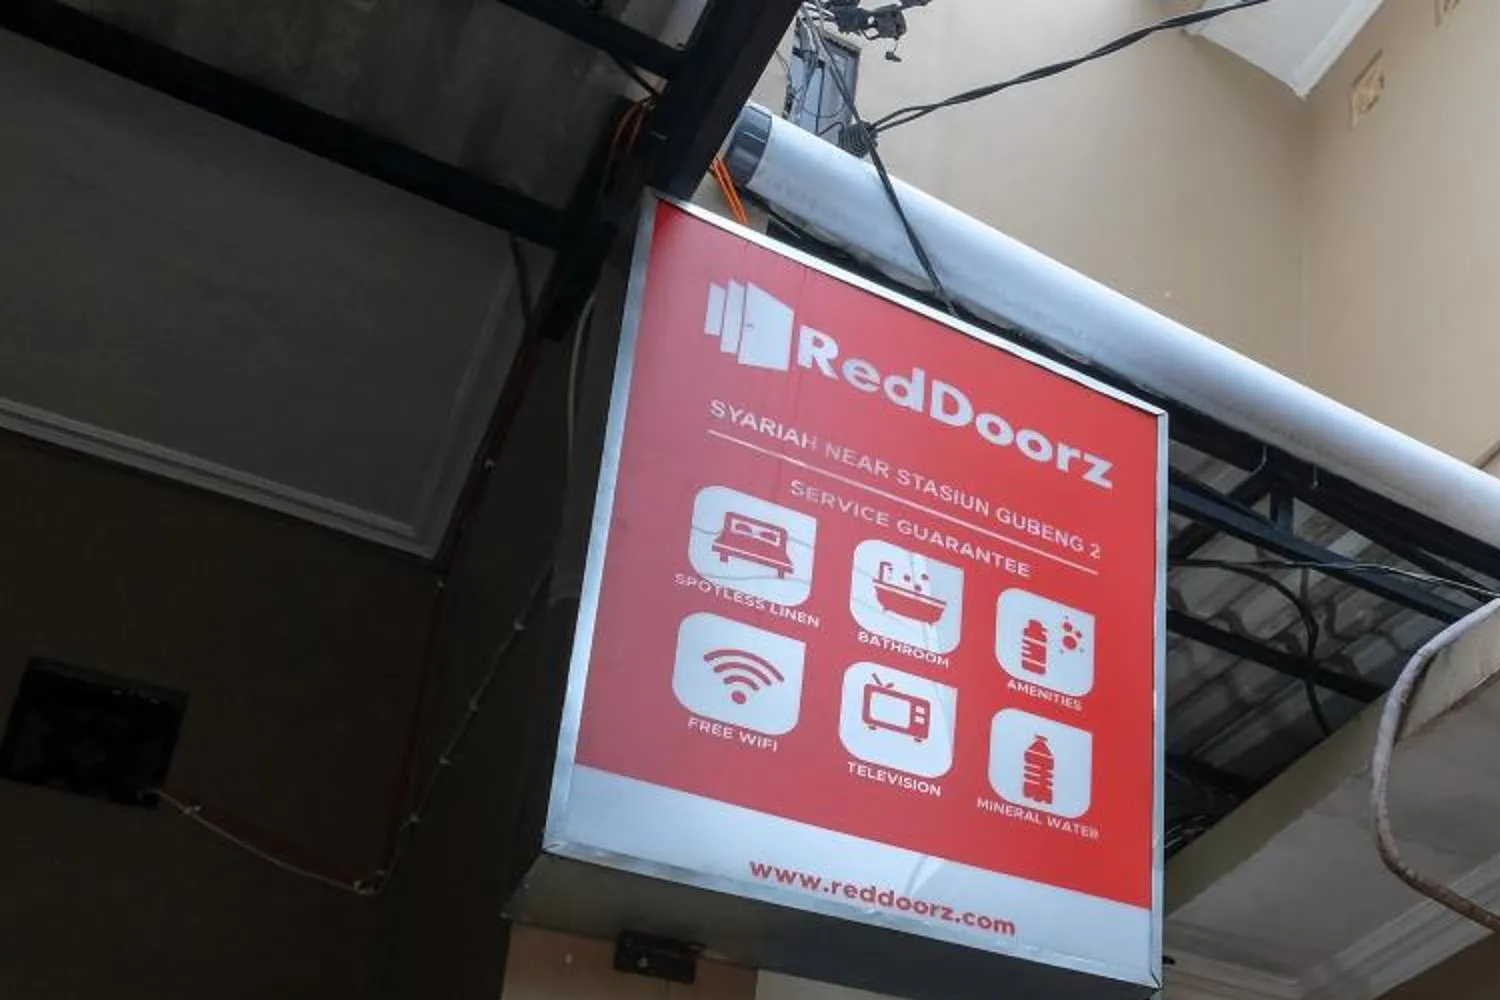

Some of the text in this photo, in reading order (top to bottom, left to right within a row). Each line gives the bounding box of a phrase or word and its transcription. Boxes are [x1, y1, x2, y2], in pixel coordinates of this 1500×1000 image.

[798, 324, 1113, 489] RedDoorz
[710, 399, 1101, 560] SYARIAH NEAR STASIUN GUBENG 2
[790, 480, 1031, 579] SERVICE GUARANTEE
[673, 572, 821, 629] SPOTLESS LINEN
[857, 631, 950, 669] BATHROOM
[1007, 678, 1083, 712] AMENITIES
[688, 717, 736, 742] FREE
[847, 760, 942, 797] TELEVISION
[977, 797, 1100, 841] MINERAL WATER
[749, 860, 1016, 937] www.reddoorz.com
